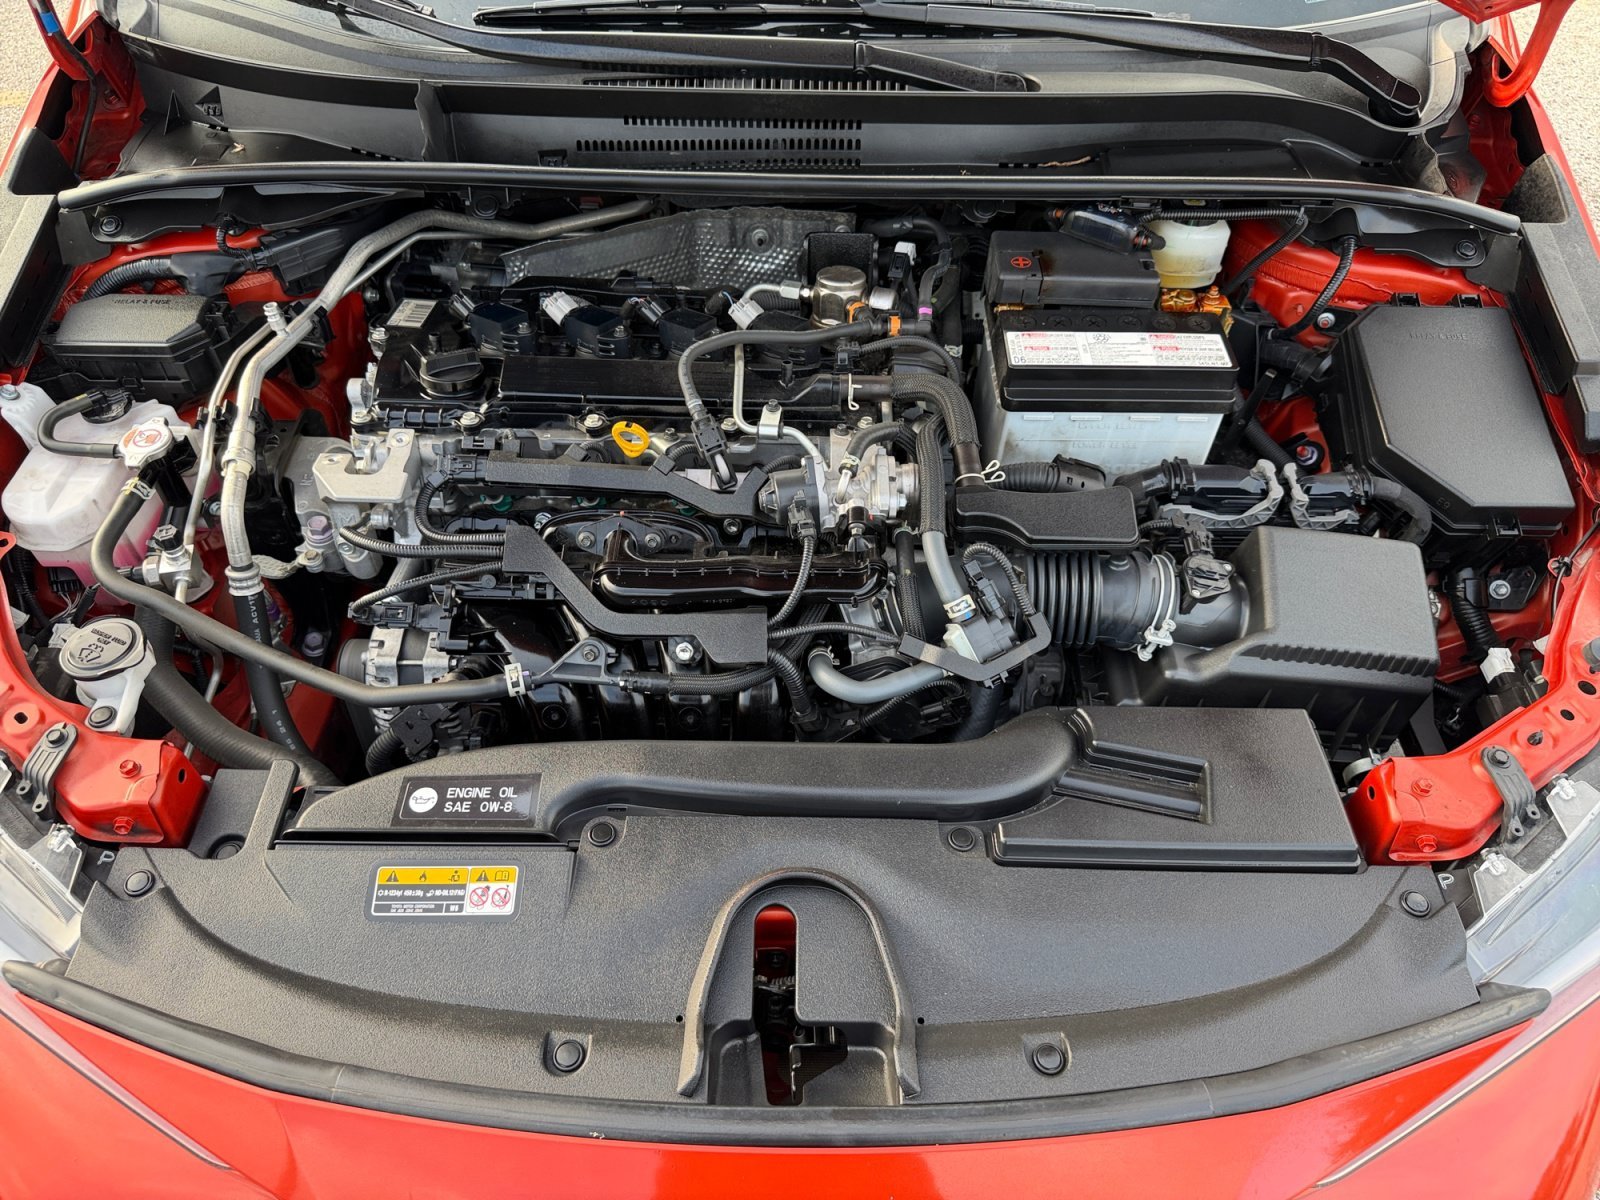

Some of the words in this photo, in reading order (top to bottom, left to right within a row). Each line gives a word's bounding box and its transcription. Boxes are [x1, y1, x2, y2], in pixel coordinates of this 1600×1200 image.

[446, 787, 492, 798] ENGINE
[499, 786, 518, 798] OIL
[444, 801, 472, 812] SAE
[479, 801, 513, 812] 0W-8
